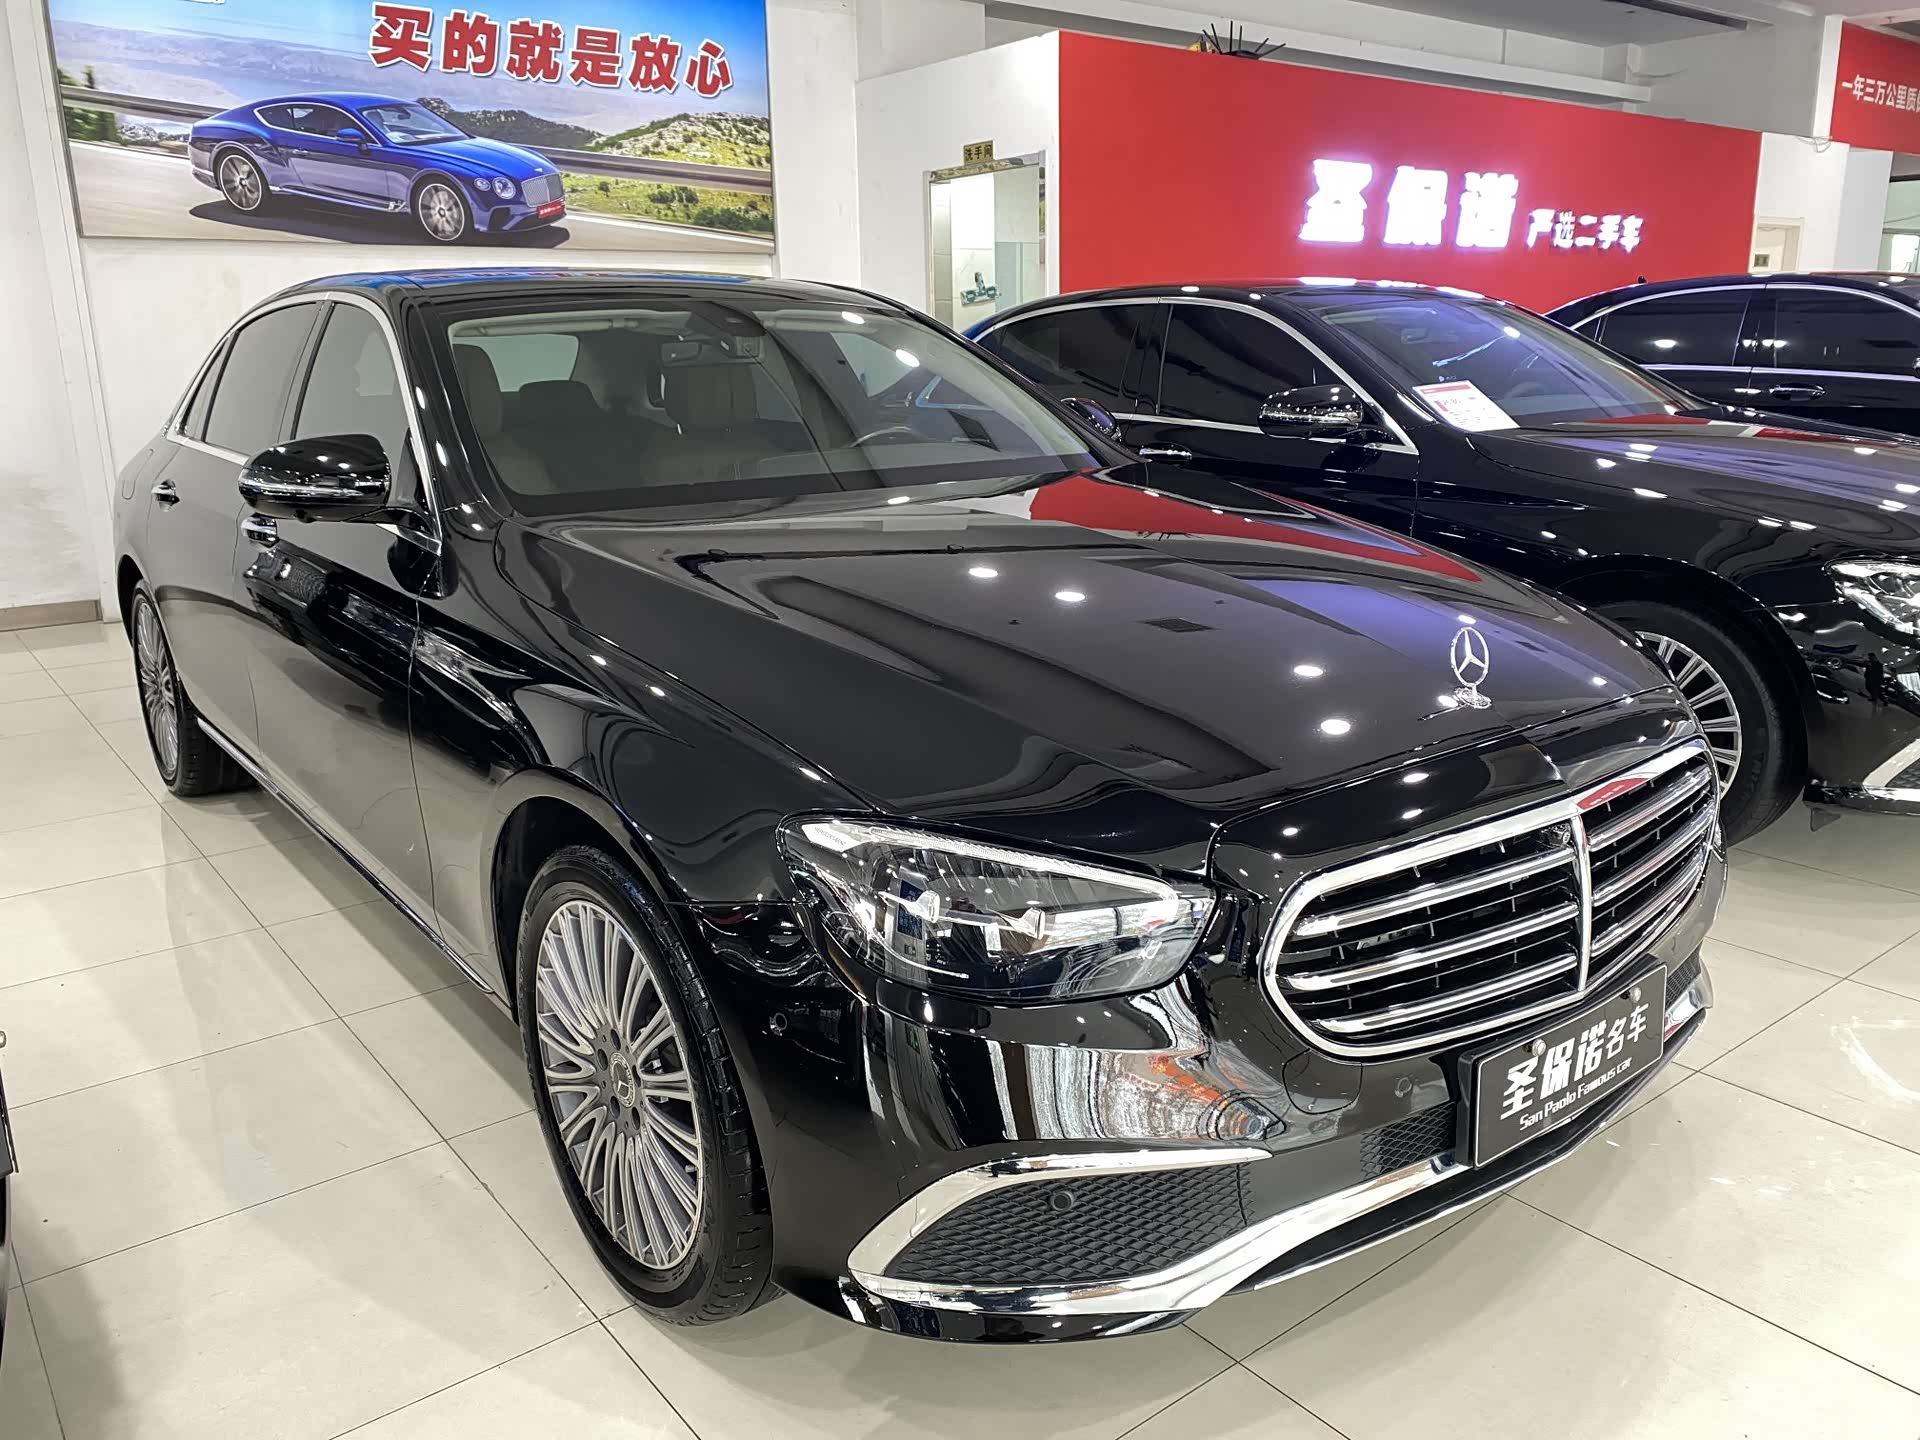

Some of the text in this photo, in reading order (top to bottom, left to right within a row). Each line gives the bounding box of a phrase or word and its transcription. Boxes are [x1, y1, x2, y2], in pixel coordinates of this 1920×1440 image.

[370, 2, 733, 98] 买的就是放心
[1526, 208, 1644, 253] 严选二手车
[1501, 1003, 1649, 1120] 圣保诺名车
[1519, 1110, 1543, 1131] San
[1544, 1091, 1577, 1118] Paolo
[1577, 1067, 1616, 1099] Famous
